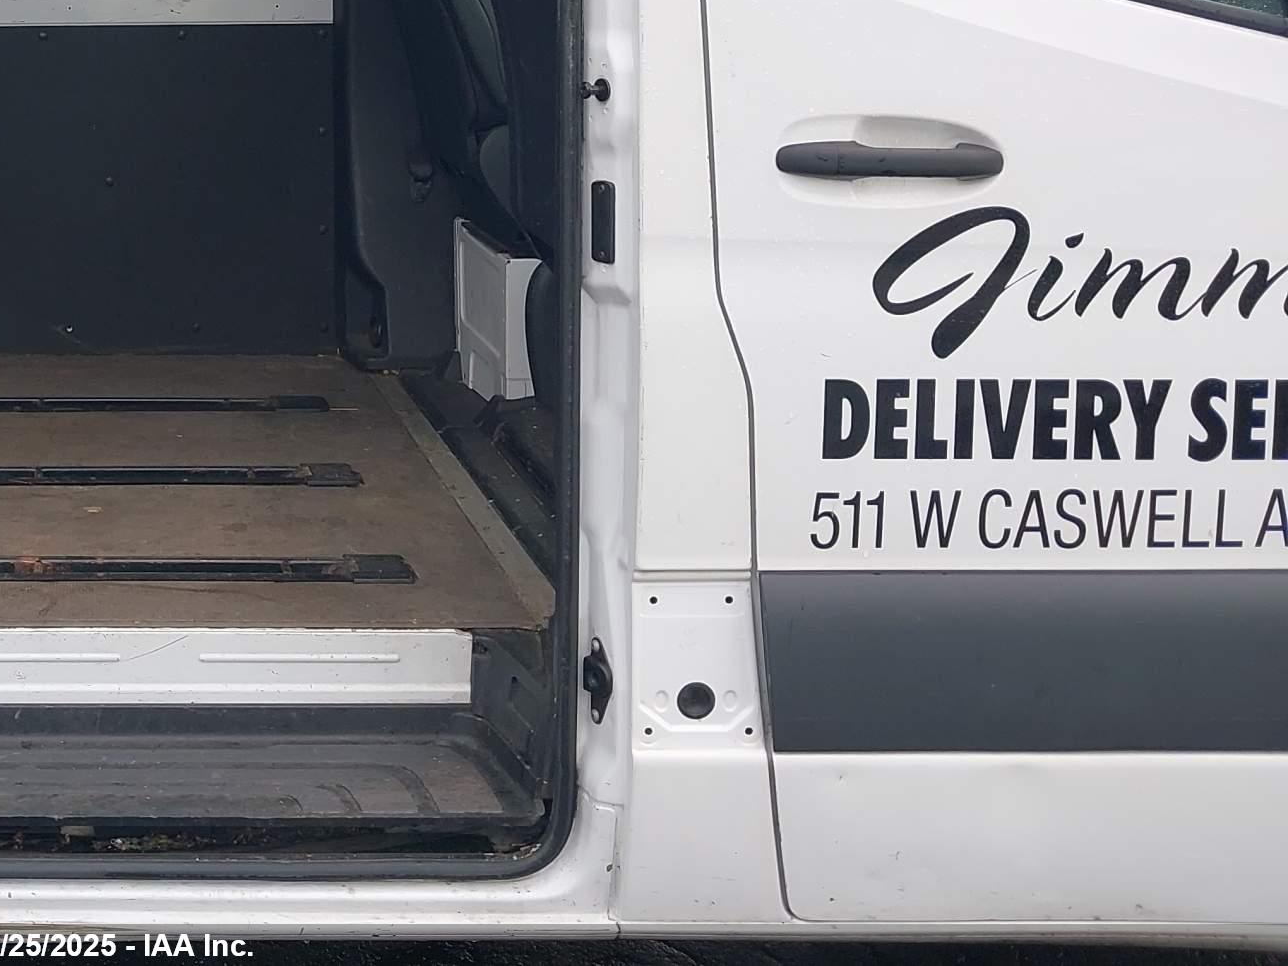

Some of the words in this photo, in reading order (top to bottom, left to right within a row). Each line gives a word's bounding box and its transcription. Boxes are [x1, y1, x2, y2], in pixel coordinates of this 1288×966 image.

[821, 378, 1173, 461] DELIVERY
[810, 490, 885, 550] 511
[910, 490, 962, 549] W
[978, 488, 1243, 550] CASWELL
